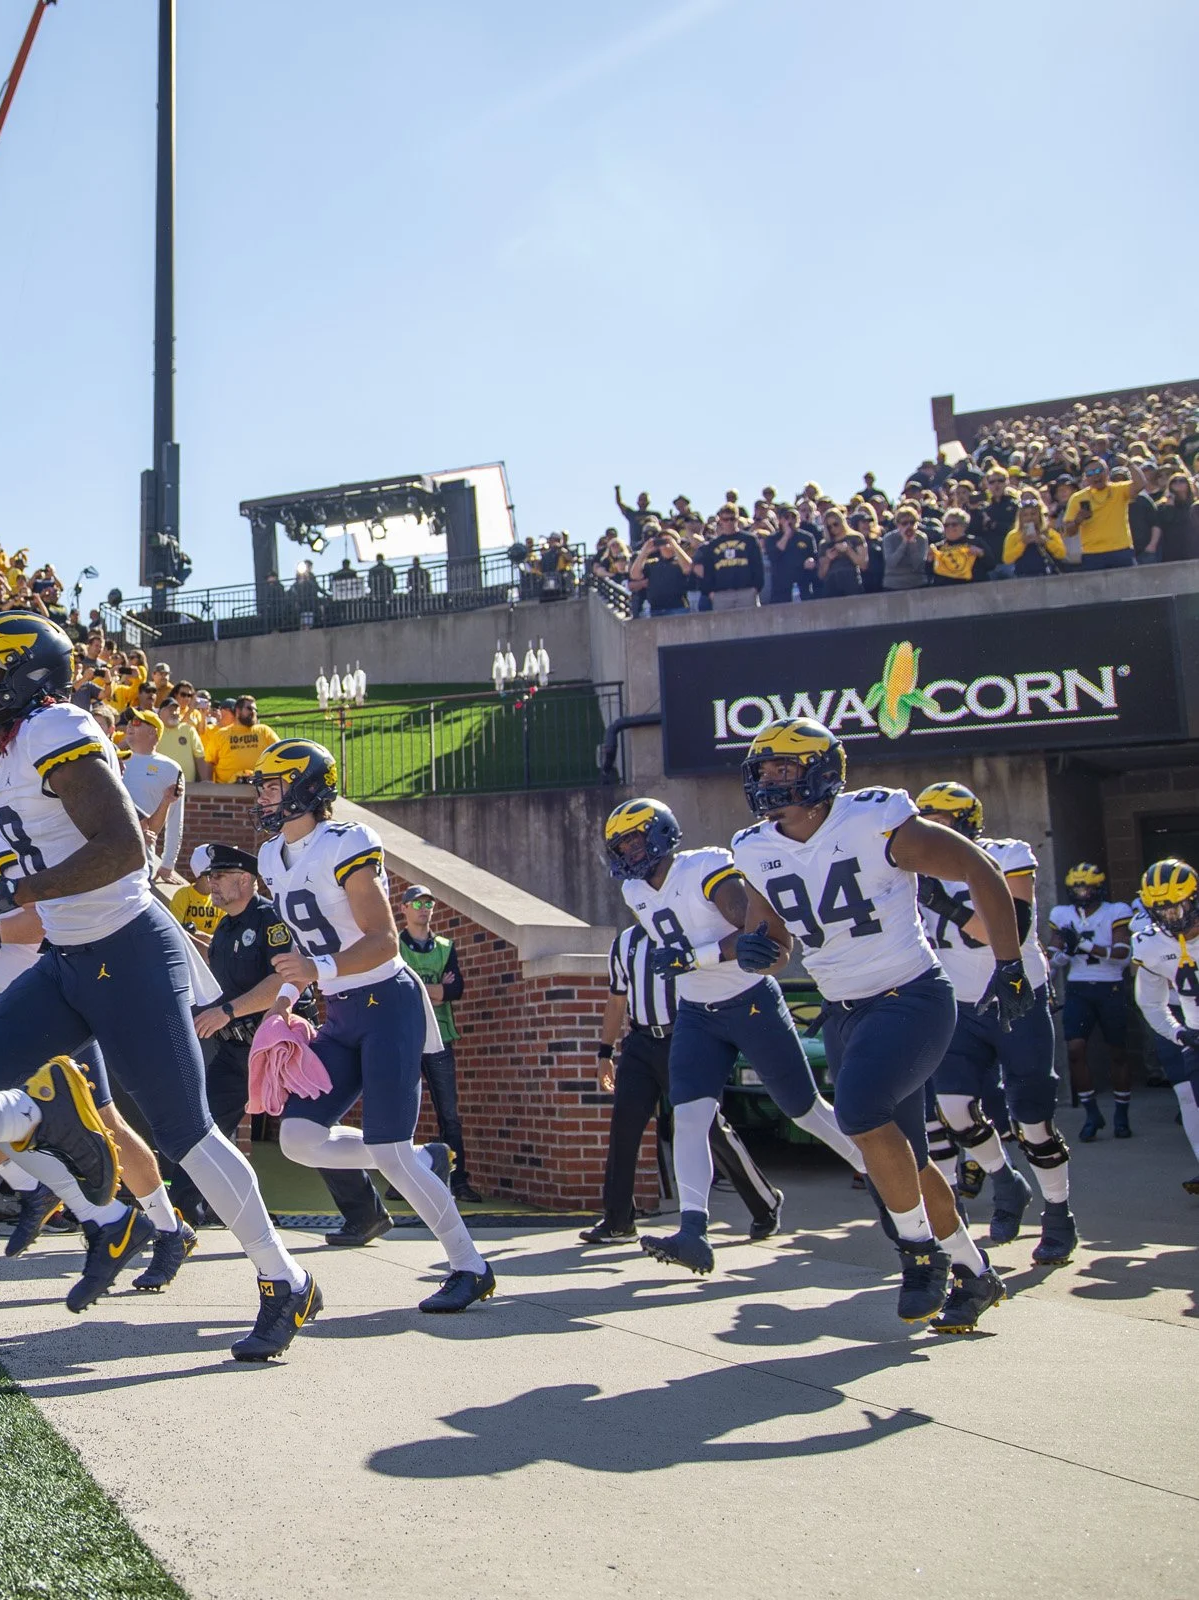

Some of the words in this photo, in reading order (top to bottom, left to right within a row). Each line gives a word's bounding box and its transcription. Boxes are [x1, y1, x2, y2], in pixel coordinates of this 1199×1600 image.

[712, 688, 879, 739] IOWA
[186, 905, 219, 918] FOOTB
[273, 888, 342, 957] 19
[765, 856, 883, 949] 94
